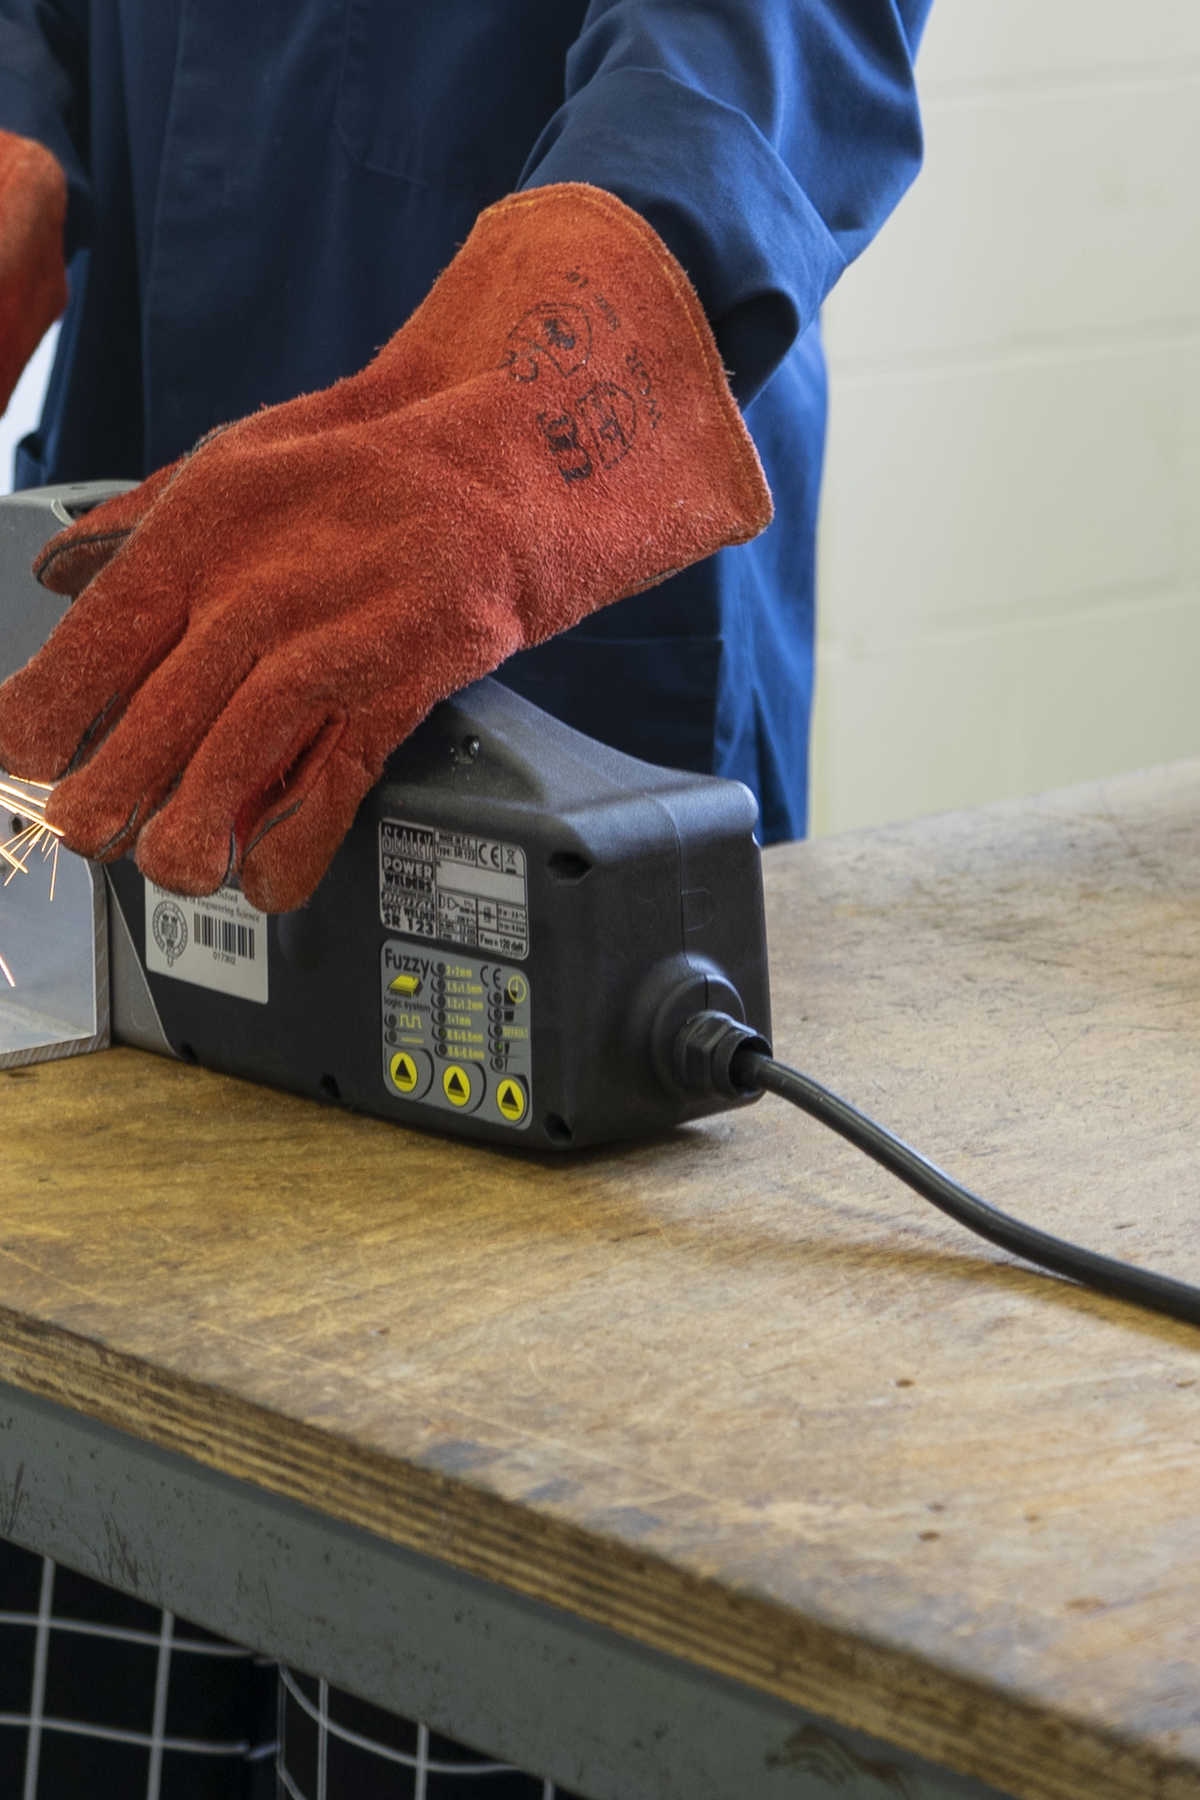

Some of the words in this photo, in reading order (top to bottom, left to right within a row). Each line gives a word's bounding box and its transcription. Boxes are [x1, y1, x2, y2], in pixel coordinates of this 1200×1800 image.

[383, 855, 432, 879] POWER
[478, 842, 499, 867] CE
[384, 913, 400, 927] SR
[407, 917, 433, 934] 123
[385, 948, 430, 980] Fuzzy
[480, 965, 503, 991] CE
